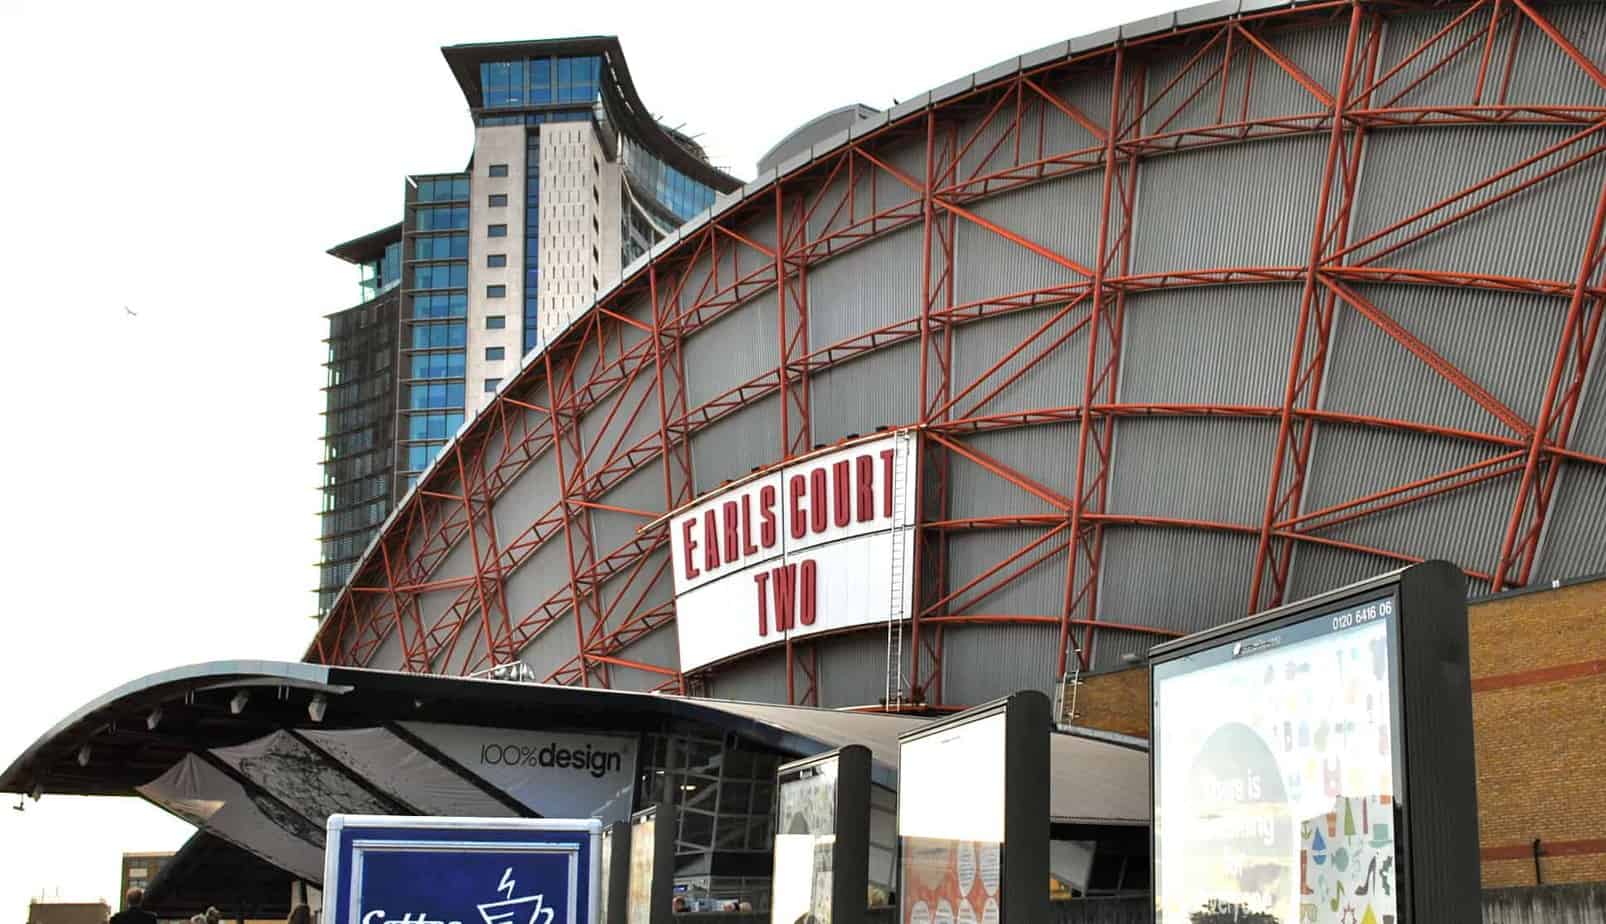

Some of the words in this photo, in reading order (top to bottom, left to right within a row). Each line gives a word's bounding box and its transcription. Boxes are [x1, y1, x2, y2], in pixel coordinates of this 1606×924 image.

[682, 485, 776, 580] EARLS
[790, 448, 894, 539] COURT
[754, 559, 817, 637] TWO
[1332, 614, 1352, 630] 0120
[1379, 601, 1392, 616] 06
